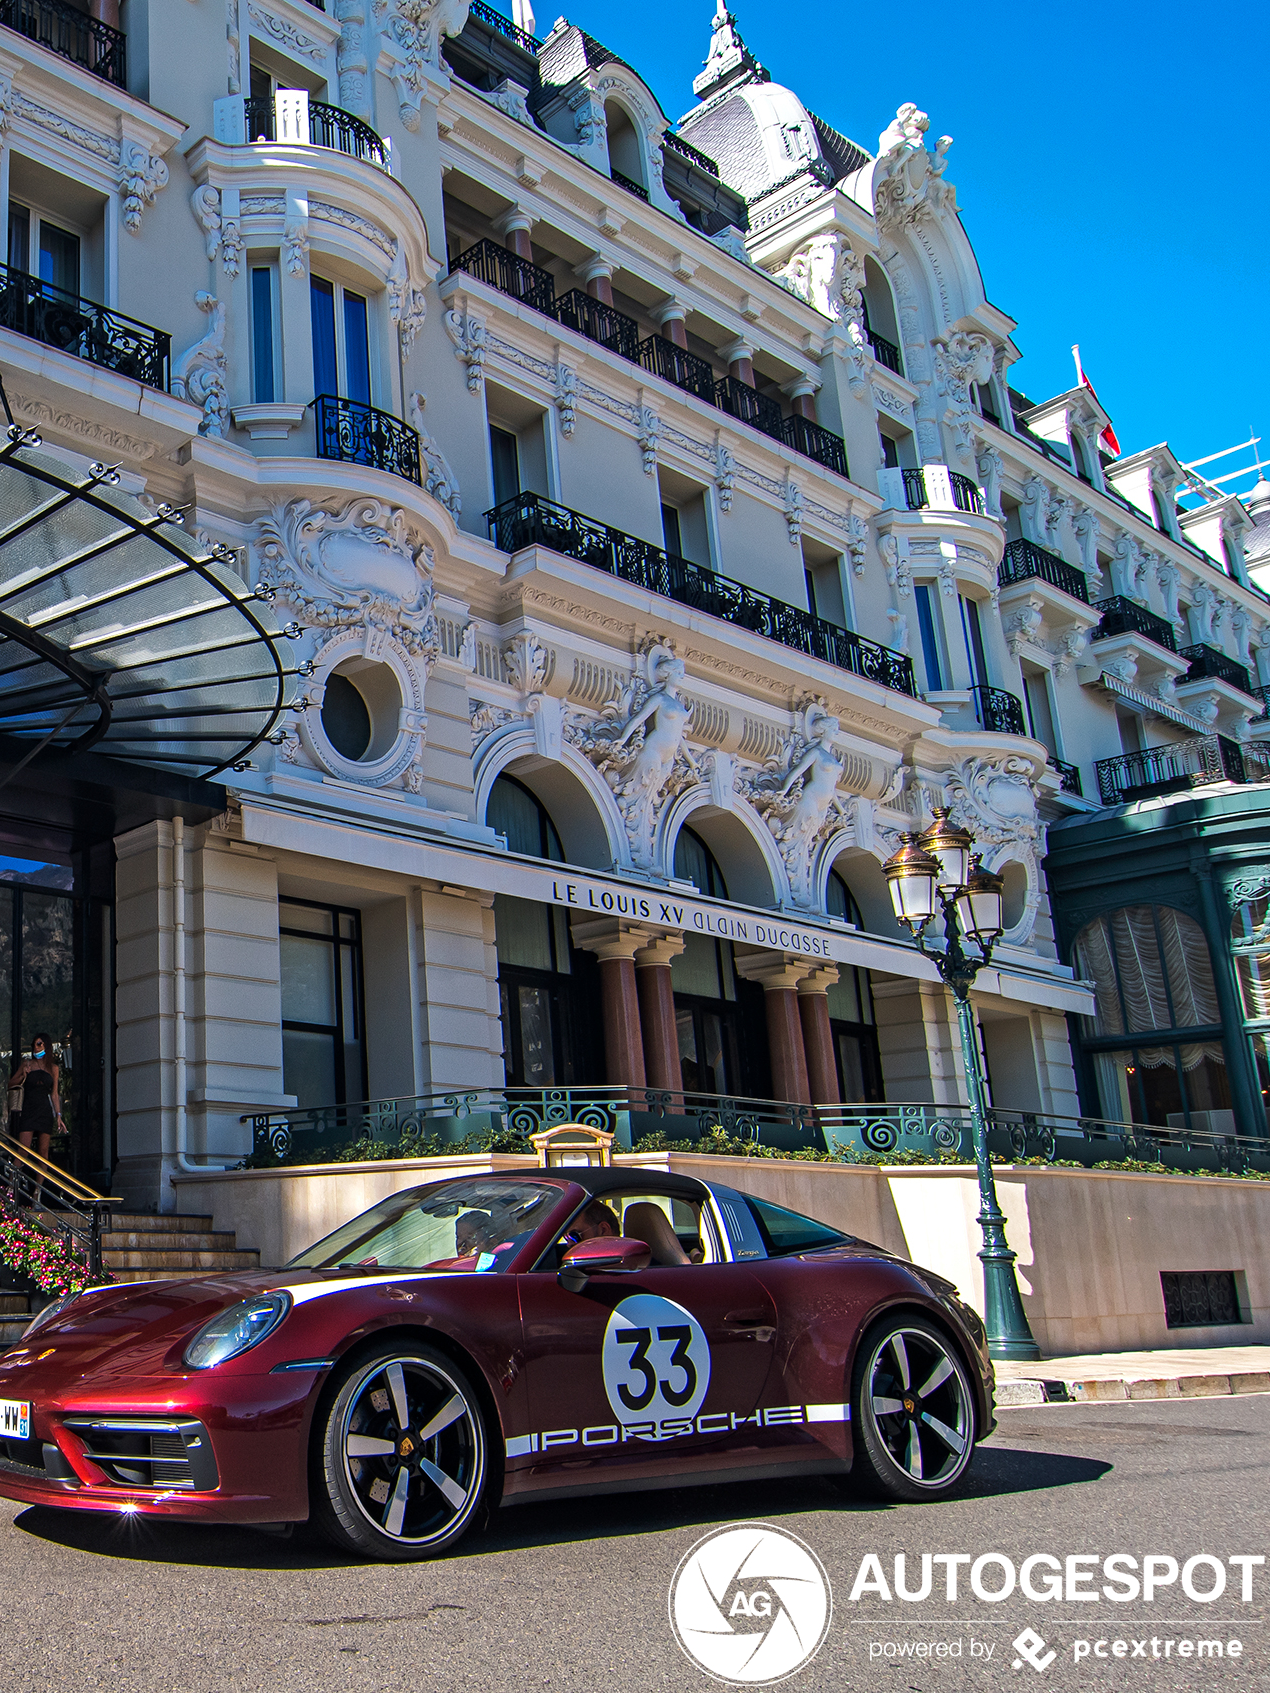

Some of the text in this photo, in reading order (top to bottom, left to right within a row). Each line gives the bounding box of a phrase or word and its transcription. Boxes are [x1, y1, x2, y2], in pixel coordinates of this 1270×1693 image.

[552, 881, 578, 903] LE
[588, 889, 650, 918] LOUIS
[659, 903, 684, 925] XV
[615, 1324, 698, 1412] 33
[541, 1406, 804, 1451] PORSCHE
